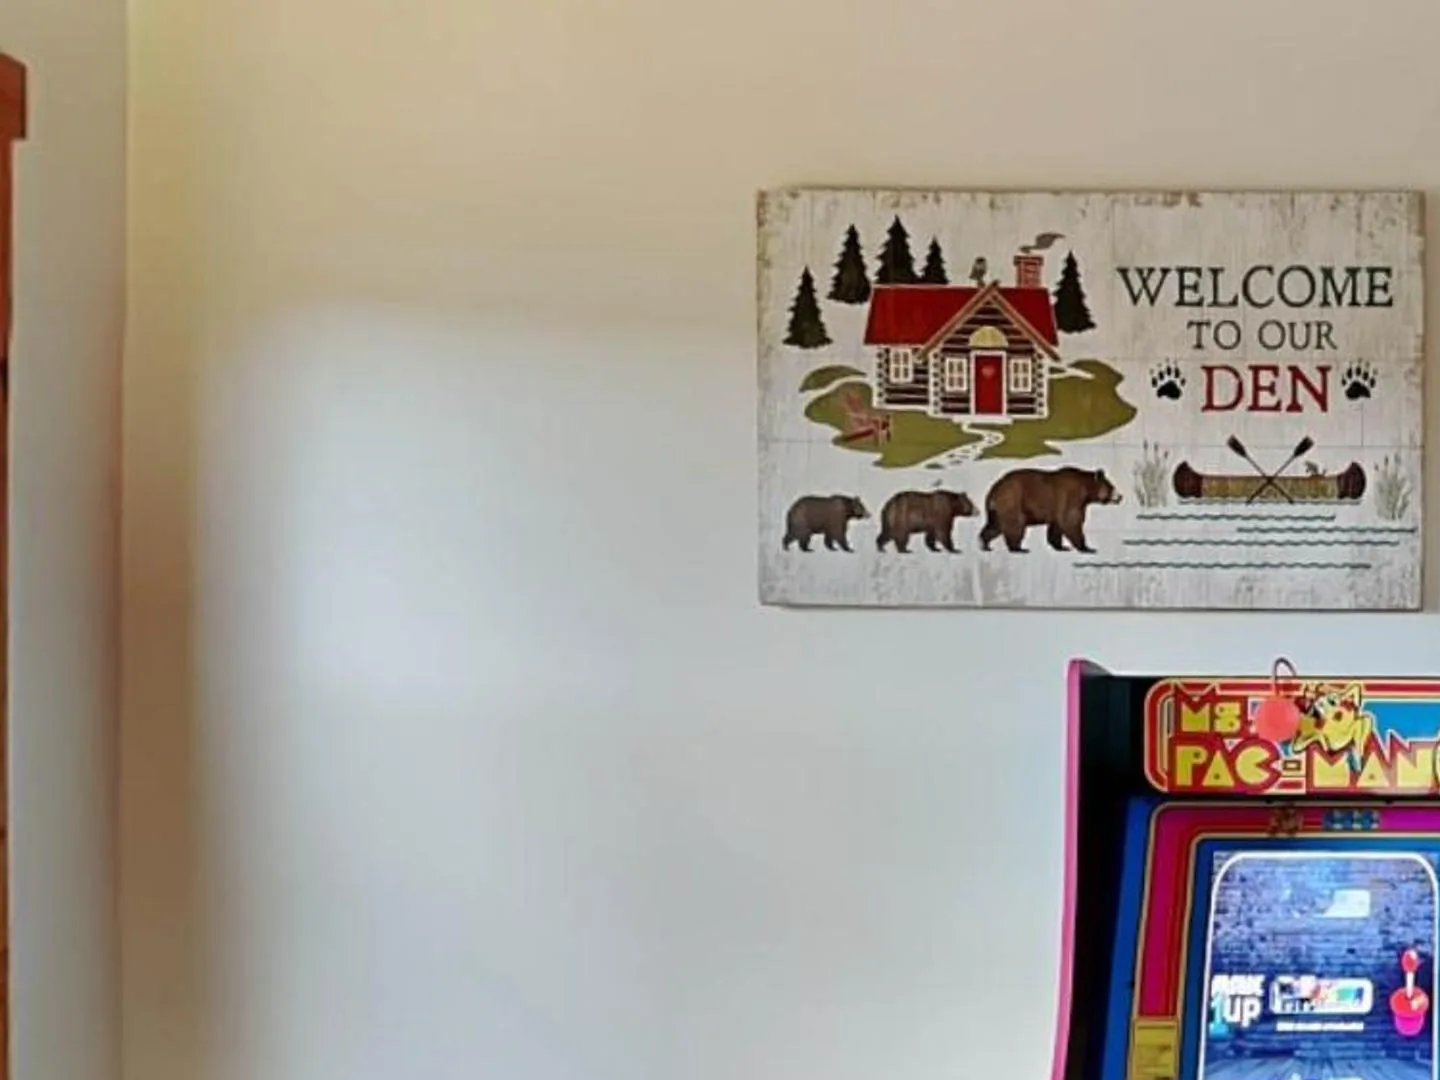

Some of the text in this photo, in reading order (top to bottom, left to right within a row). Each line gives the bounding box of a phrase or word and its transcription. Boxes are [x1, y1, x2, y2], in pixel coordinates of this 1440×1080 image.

[1117, 265, 1395, 309] WELCOME
[1187, 320, 1338, 350] TO OUR
[1200, 365, 1332, 413] DEN
